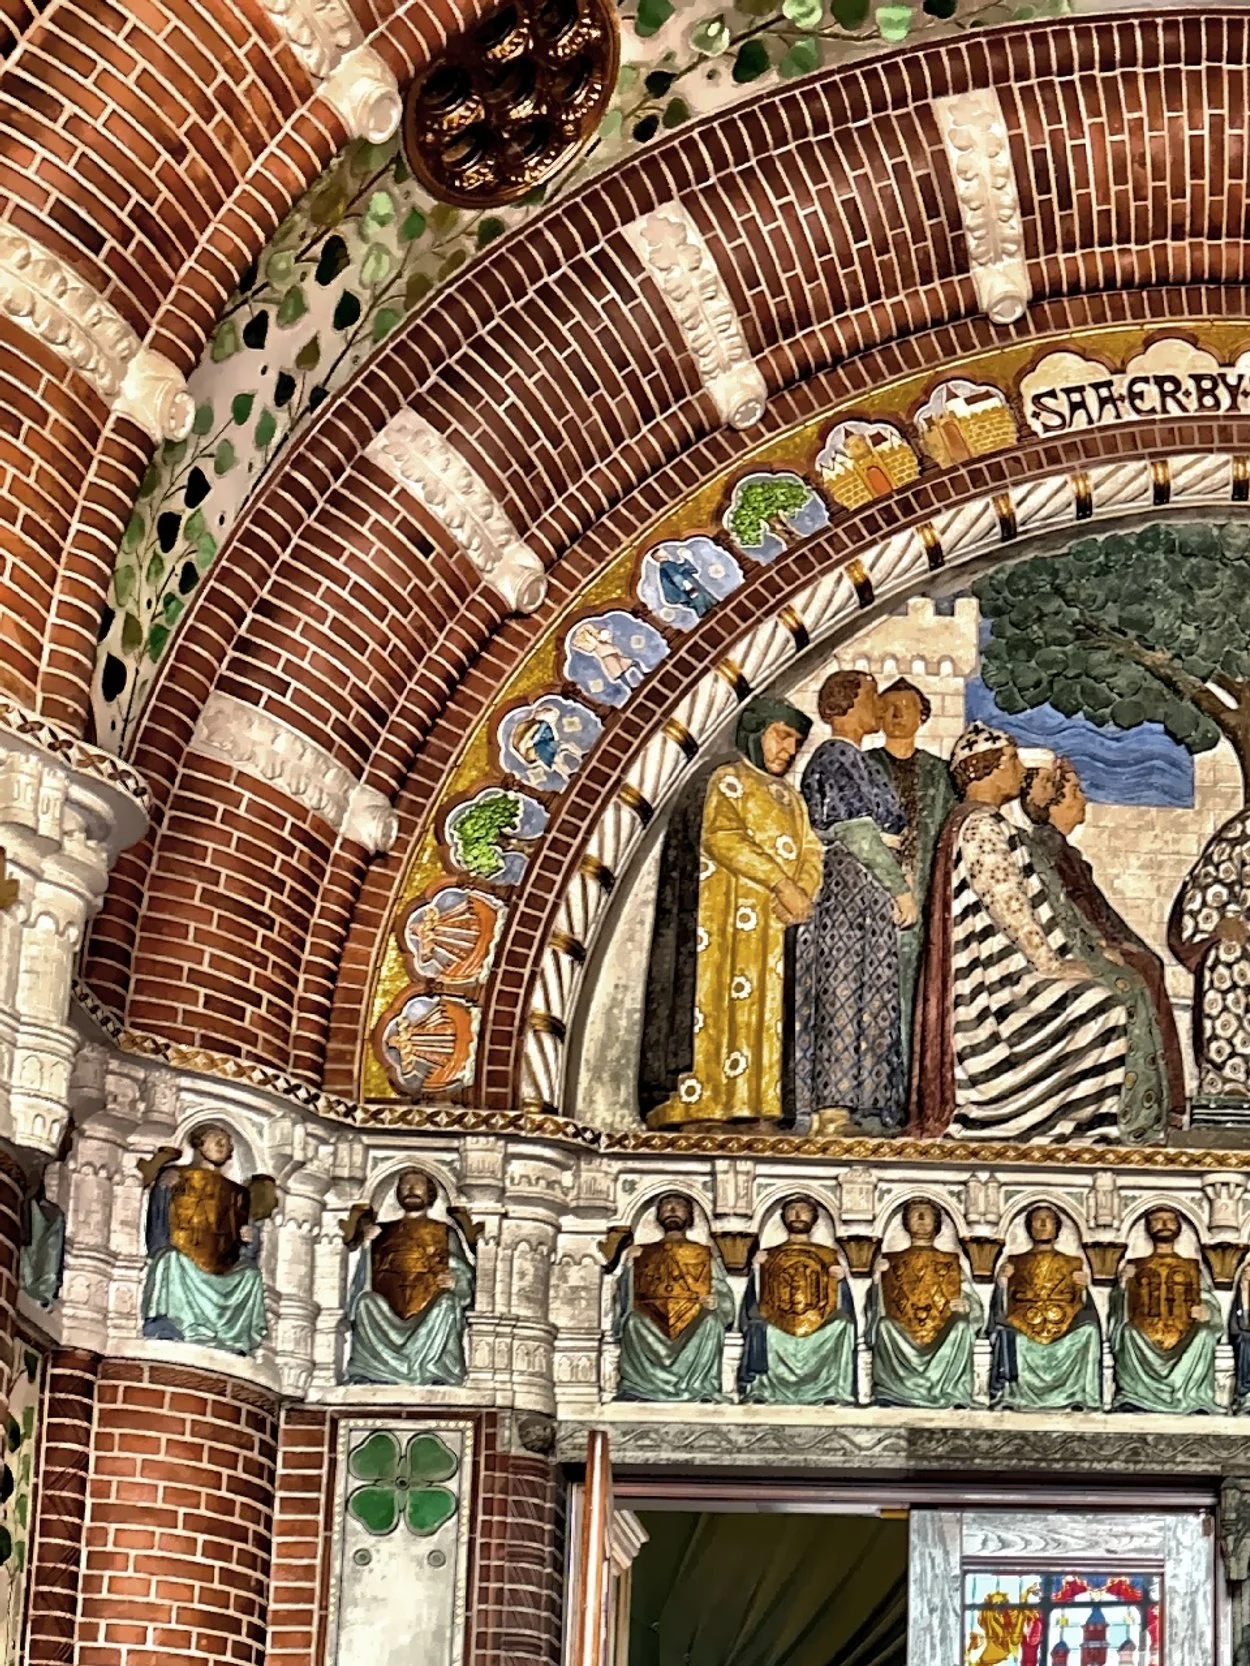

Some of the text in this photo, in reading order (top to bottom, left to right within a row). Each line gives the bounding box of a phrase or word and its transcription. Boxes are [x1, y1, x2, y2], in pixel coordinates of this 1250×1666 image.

[1031, 380, 1122, 433] SAA
[1126, 374, 1191, 417] ER
[1188, 373, 1244, 413] BY
